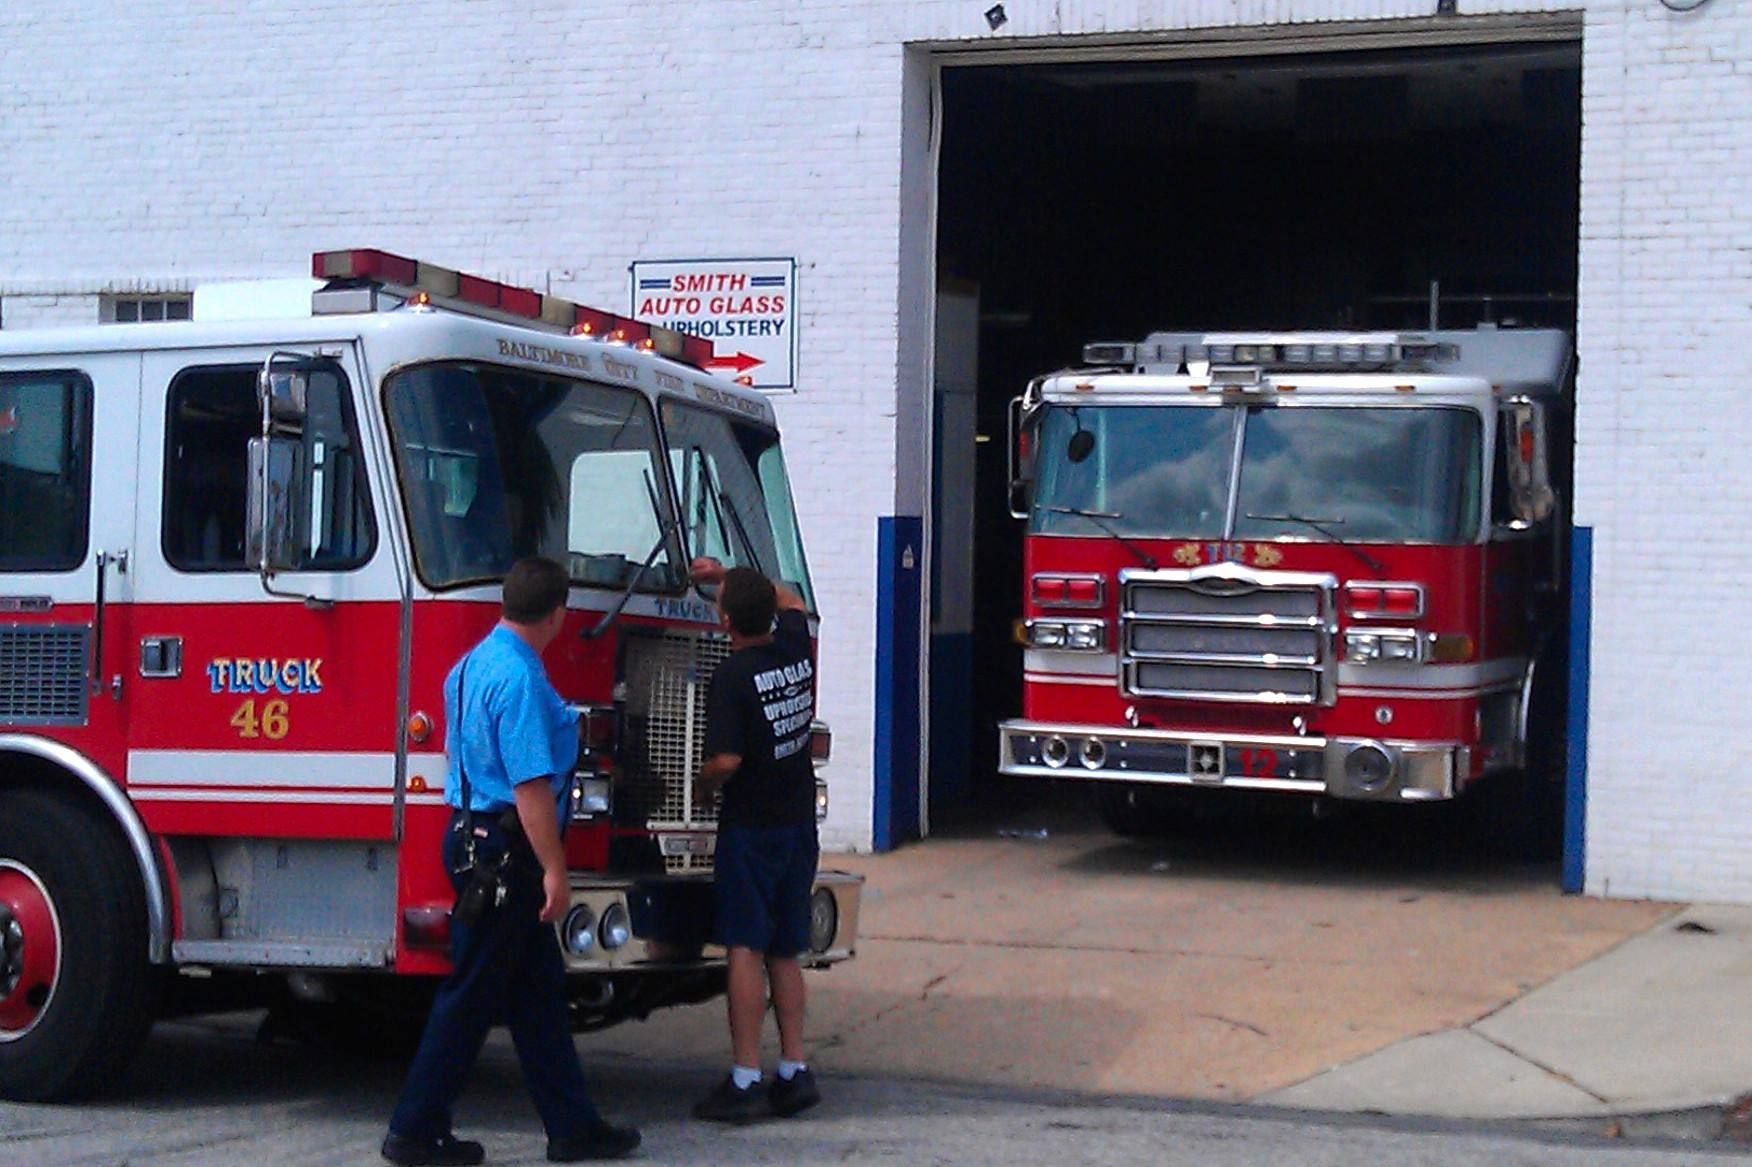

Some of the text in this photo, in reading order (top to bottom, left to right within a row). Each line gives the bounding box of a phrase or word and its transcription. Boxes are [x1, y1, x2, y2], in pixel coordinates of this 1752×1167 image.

[672, 274, 746, 292] SMITH
[640, 296, 785, 315] AUTO GLASS
[206, 656, 323, 694] TRUCK
[754, 668, 786, 693] AUTO
[230, 699, 289, 740] 46
[1239, 747, 1279, 778] 12
